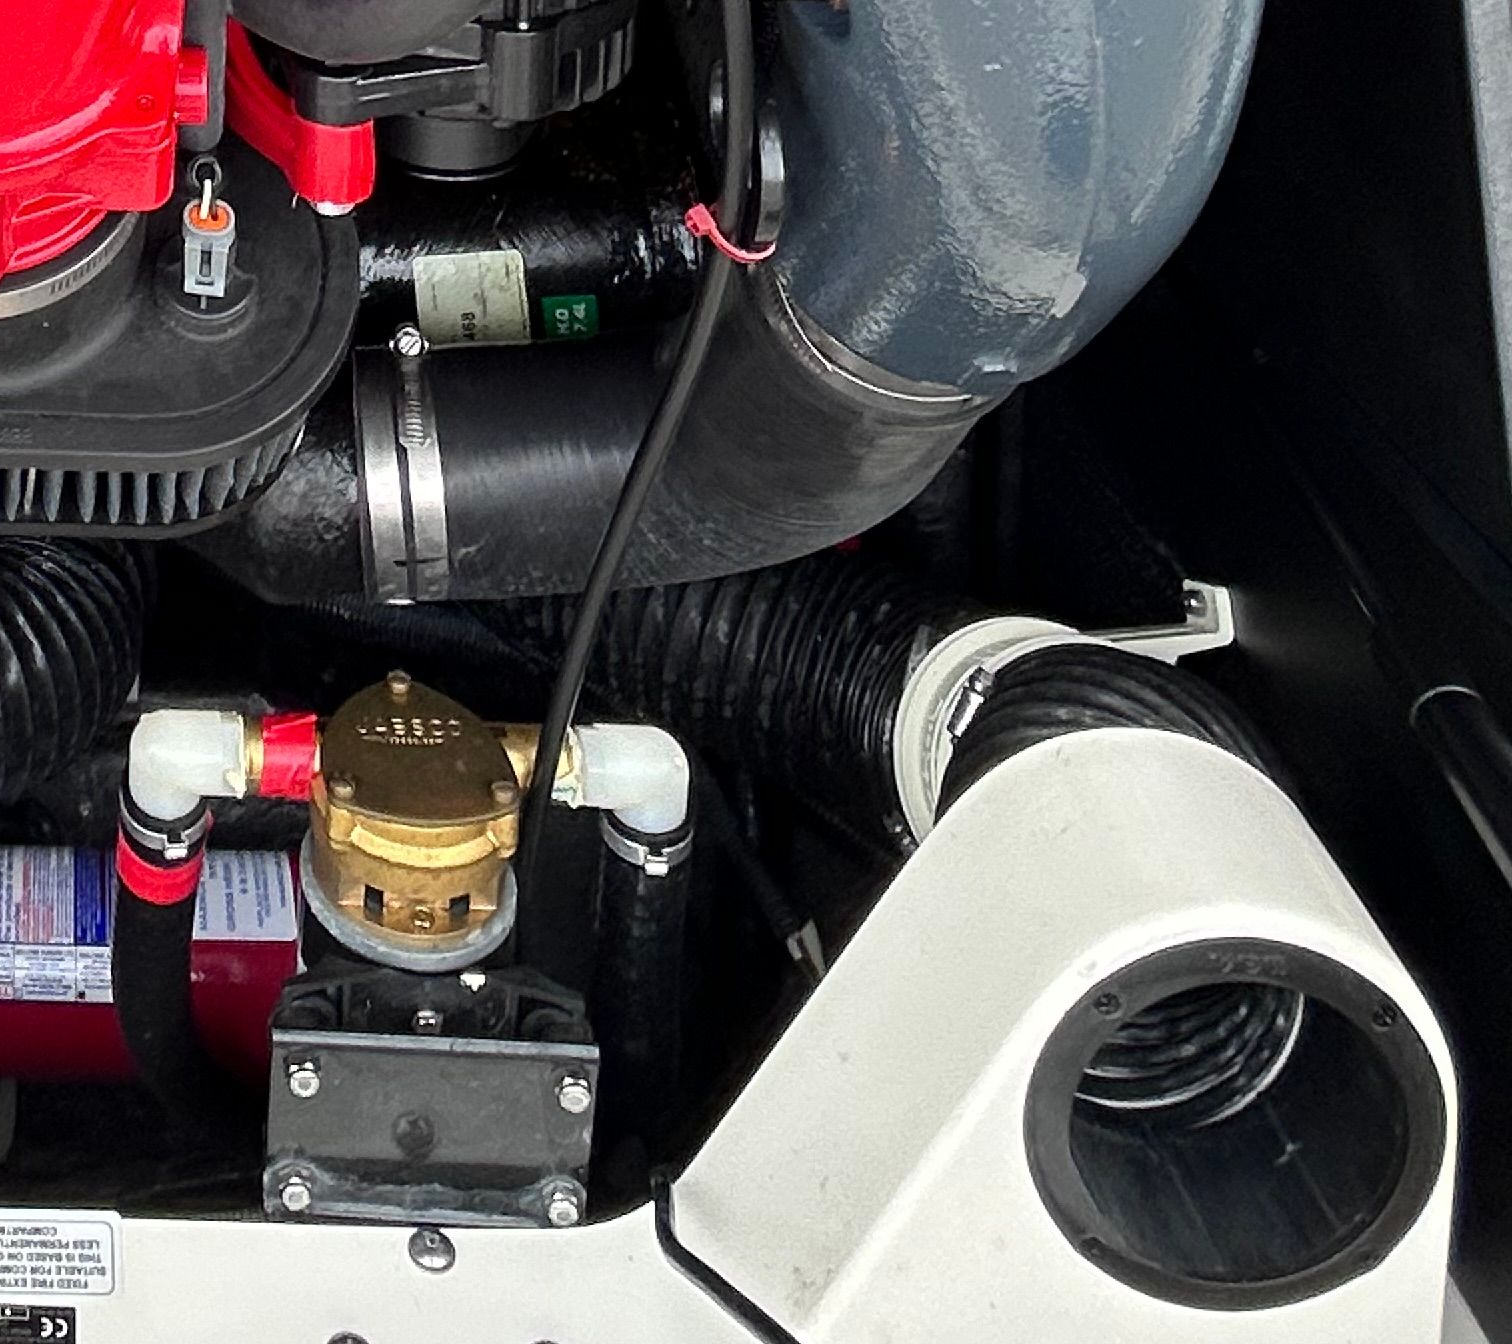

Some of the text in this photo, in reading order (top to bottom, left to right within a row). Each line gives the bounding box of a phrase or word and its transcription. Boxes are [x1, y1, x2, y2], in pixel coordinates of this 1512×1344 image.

[73, 1239, 100, 1250] LESS
[78, 1253, 101, 1263] THIS
[31, 1278, 54, 1289] FIRE
[57, 1279, 88, 1289] FIXED
